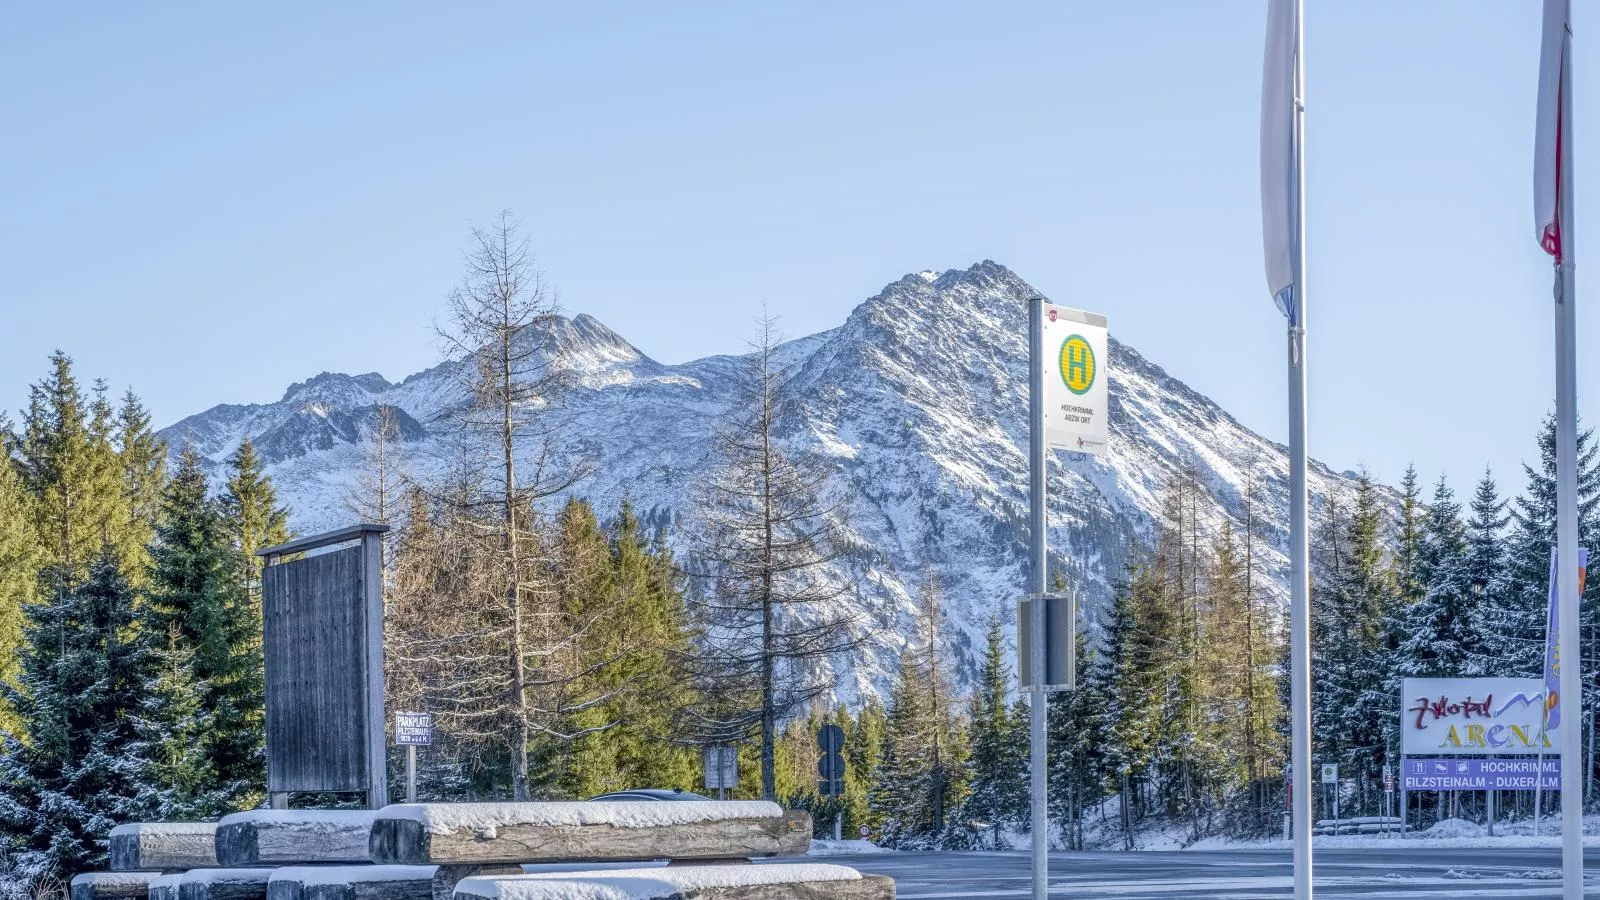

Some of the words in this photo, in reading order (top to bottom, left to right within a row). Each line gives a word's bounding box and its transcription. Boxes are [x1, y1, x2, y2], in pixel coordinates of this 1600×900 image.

[1069, 345, 1087, 384] H
[1061, 404, 1094, 416] HOCHKRIMML
[398, 715, 429, 727] PARKPLATZ
[1480, 762, 1559, 773] HOCHKRIMML
